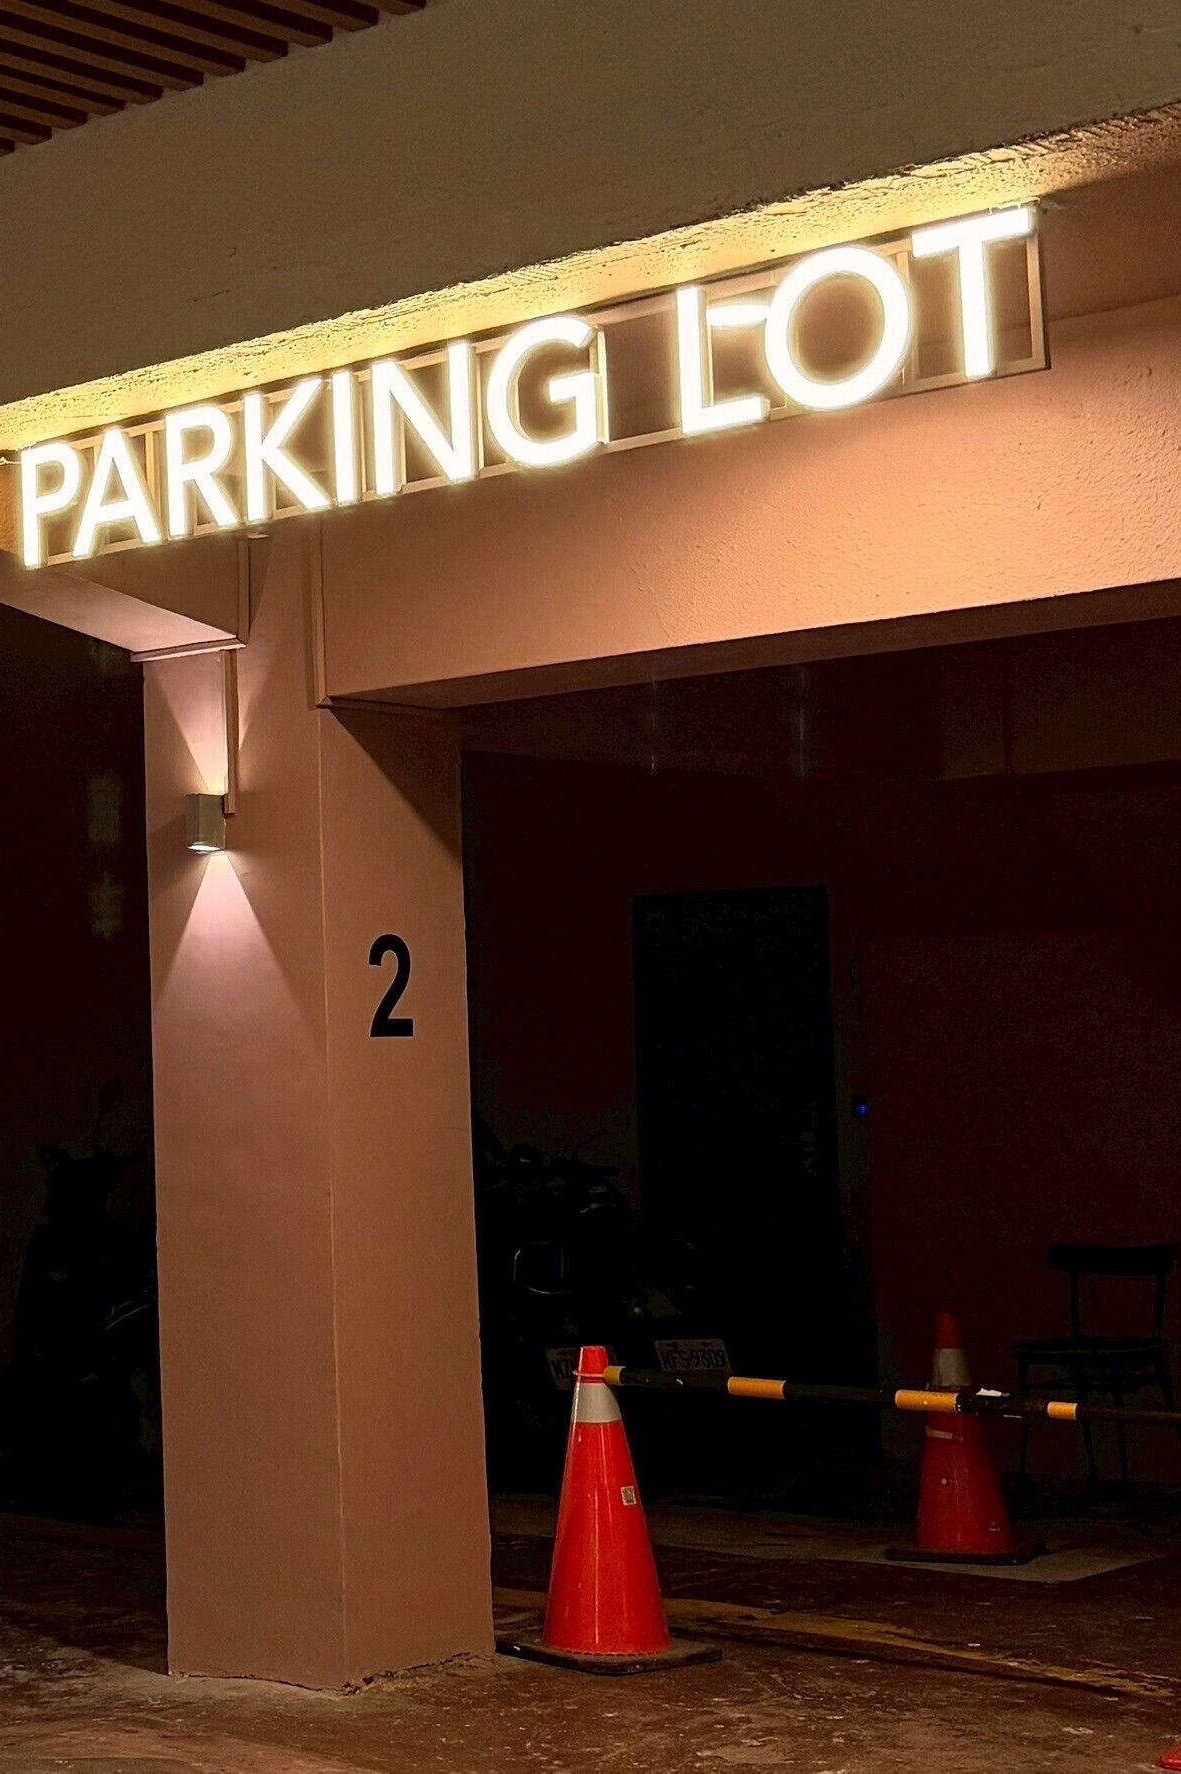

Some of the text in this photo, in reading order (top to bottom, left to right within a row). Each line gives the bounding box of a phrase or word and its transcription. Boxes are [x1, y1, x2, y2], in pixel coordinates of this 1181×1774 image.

[19, 206, 1032, 569] PARKING LOT
[369, 933, 414, 1037] 2
